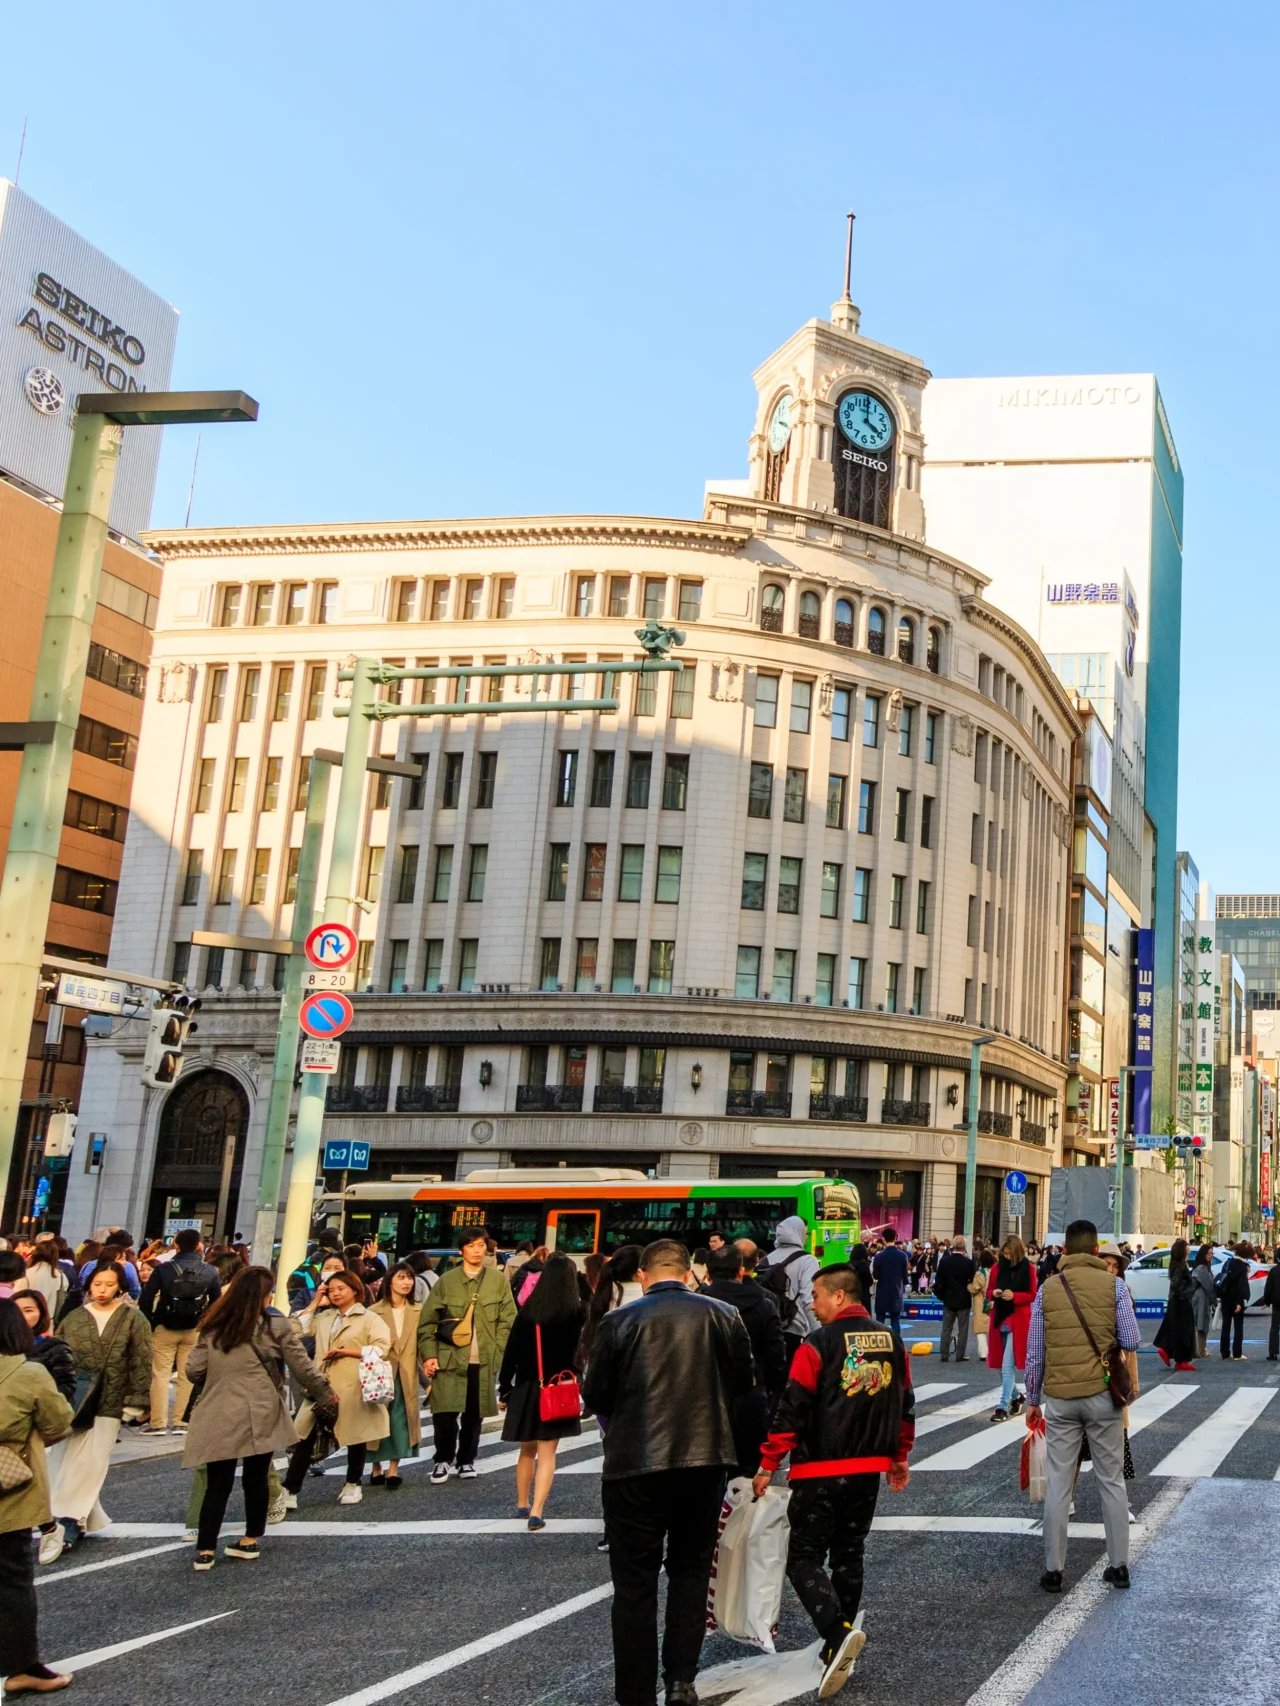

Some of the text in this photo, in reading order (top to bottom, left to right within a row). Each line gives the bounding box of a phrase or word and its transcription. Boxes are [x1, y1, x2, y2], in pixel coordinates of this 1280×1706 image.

[33, 271, 147, 366] SEIKO
[17, 307, 147, 393] ASTRON
[998, 386, 1141, 407] MIKIMOTO
[842, 449, 888, 472] SEIKO
[1047, 582, 1118, 602] 山野楽器
[1197, 936, 1213, 1020] 教文館
[64, 983, 120, 1004] 銀座四丁目
[1137, 970, 1153, 1051] 山野楽器
[1196, 1068, 1211, 1087] 本
[855, 1335, 887, 1348] GUCCI
